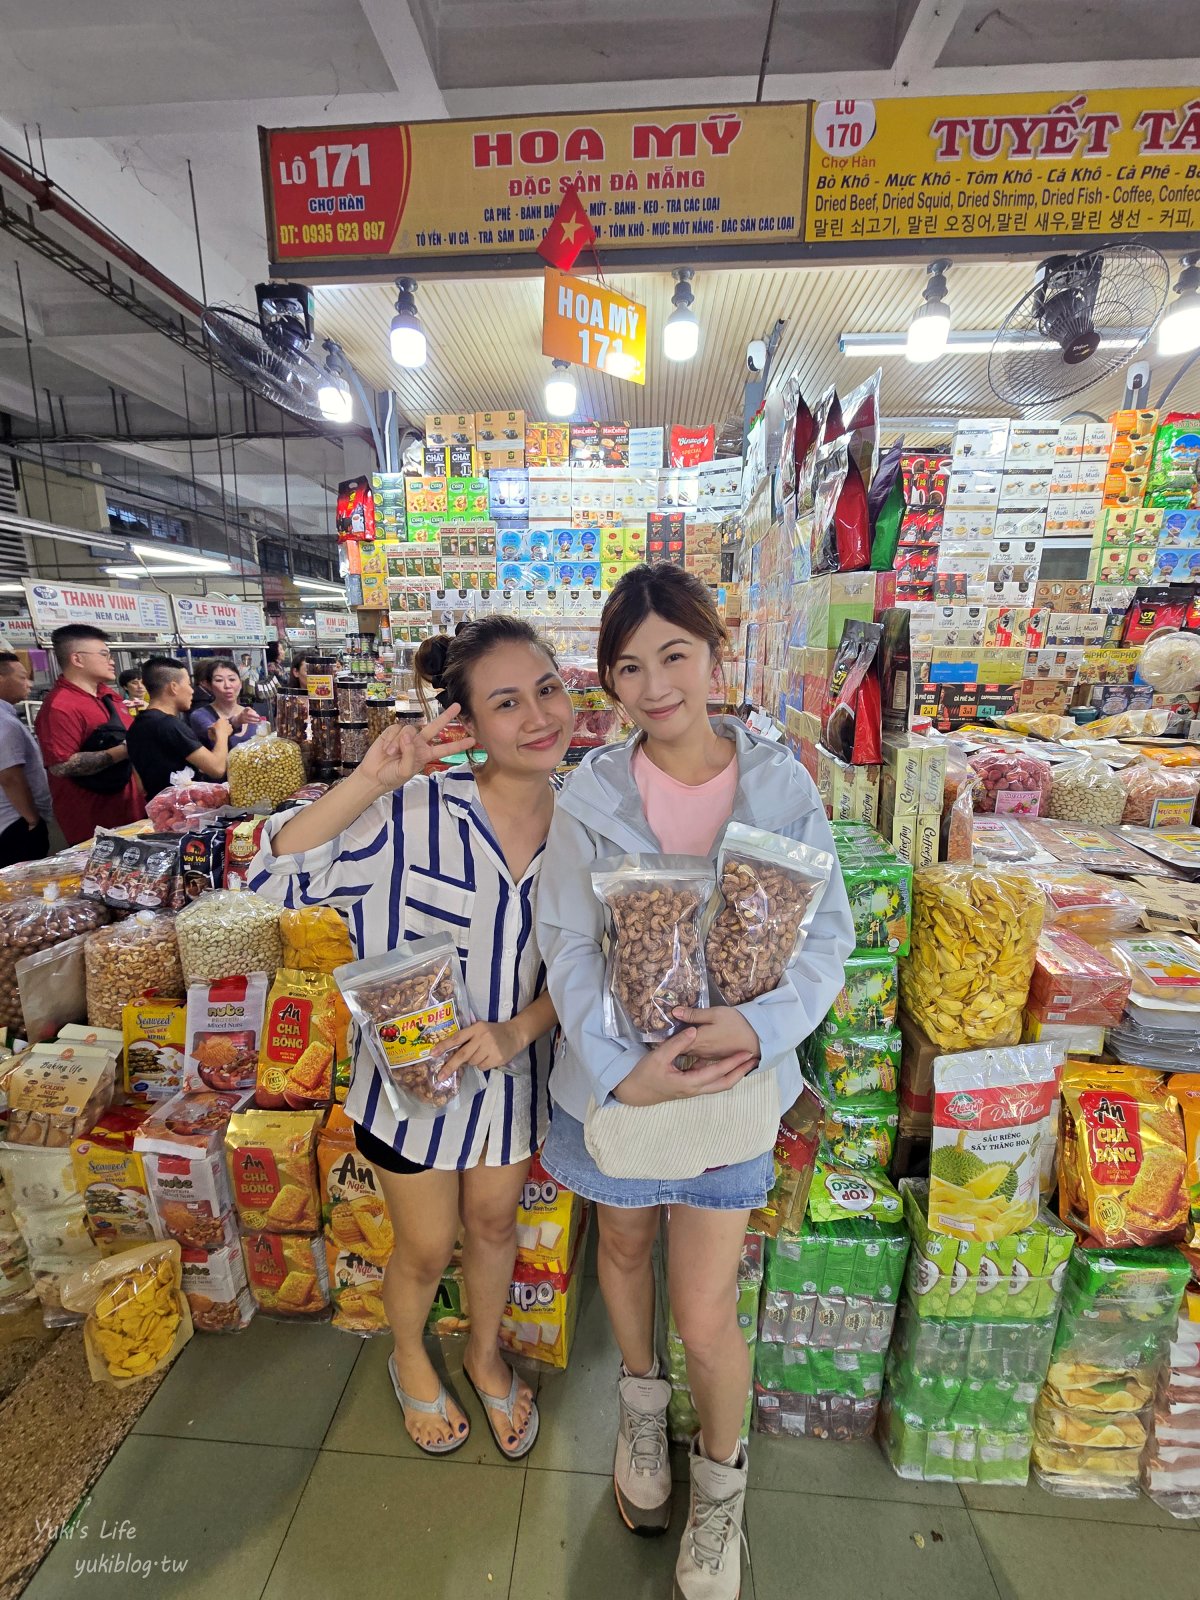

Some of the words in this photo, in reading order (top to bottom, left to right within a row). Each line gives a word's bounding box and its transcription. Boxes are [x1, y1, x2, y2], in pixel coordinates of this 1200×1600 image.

[826, 122, 862, 148] 170
[929, 94, 1123, 162] TUYẾT
[473, 127, 604, 168] HOA
[632, 112, 743, 160] MỸ
[279, 156, 307, 185] LÔ
[309, 143, 371, 188] 171
[821, 156, 849, 171] Chợ
[852, 155, 876, 168] Hàn
[509, 175, 551, 199] ĐẶC
[559, 170, 601, 193] SẢN
[609, 170, 639, 191] ĐÀ
[647, 165, 705, 190] NẴNG
[816, 176, 836, 190] Bò
[840, 174, 870, 189] Khô
[885, 173, 916, 190] Mực
[921, 171, 951, 187] Khô
[967, 170, 998, 185] Tôm
[1003, 168, 1033, 184] Khô
[1071, 166, 1102, 181] Khô
[1141, 164, 1171, 179] Phê
[308, 196, 336, 215] CHỢ
[338, 194, 365, 211] HÀN
[520, 204, 542, 219] BÁNH
[614, 199, 636, 215] BÁNH
[643, 198, 659, 216] KẸO
[683, 196, 700, 212] CÁC
[702, 197, 721, 213] LOẠI
[815, 194, 846, 212] Dried
[850, 193, 879, 213] Beef,
[882, 192, 914, 211] Dried
[917, 190, 954, 213] Squid,
[957, 189, 989, 208] Dried
[993, 189, 1038, 210] Shrimp,
[1042, 187, 1073, 206] Dried
[1077, 186, 1102, 205] Fish
[1113, 184, 1155, 205] Coffee,
[279, 225, 300, 244] ĐT:
[302, 224, 333, 244] 0935
[337, 223, 358, 241] 623
[363, 221, 386, 240] 897
[777, 215, 795, 233] LOẠI
[814, 218, 844, 238] 말린
[907, 215, 938, 235] 말린
[1109, 209, 1141, 230] 생선
[558, 285, 604, 329] HOA
[608, 305, 639, 340] MỸ
[61, 590, 106, 609] THANH
[108, 595, 136, 611] VINH
[95, 611, 113, 621] NEM
[136, 1012, 170, 1028] Seaweed
[278, 1002, 301, 1022] An
[272, 1035, 304, 1050] BÔNG
[1094, 1097, 1125, 1124] An
[241, 1153, 264, 1171] An
[332, 1153, 377, 1191] An
[519, 1181, 558, 1210] po
[831, 1181, 868, 1192] COCO
[842, 1189, 868, 1201] TOP
